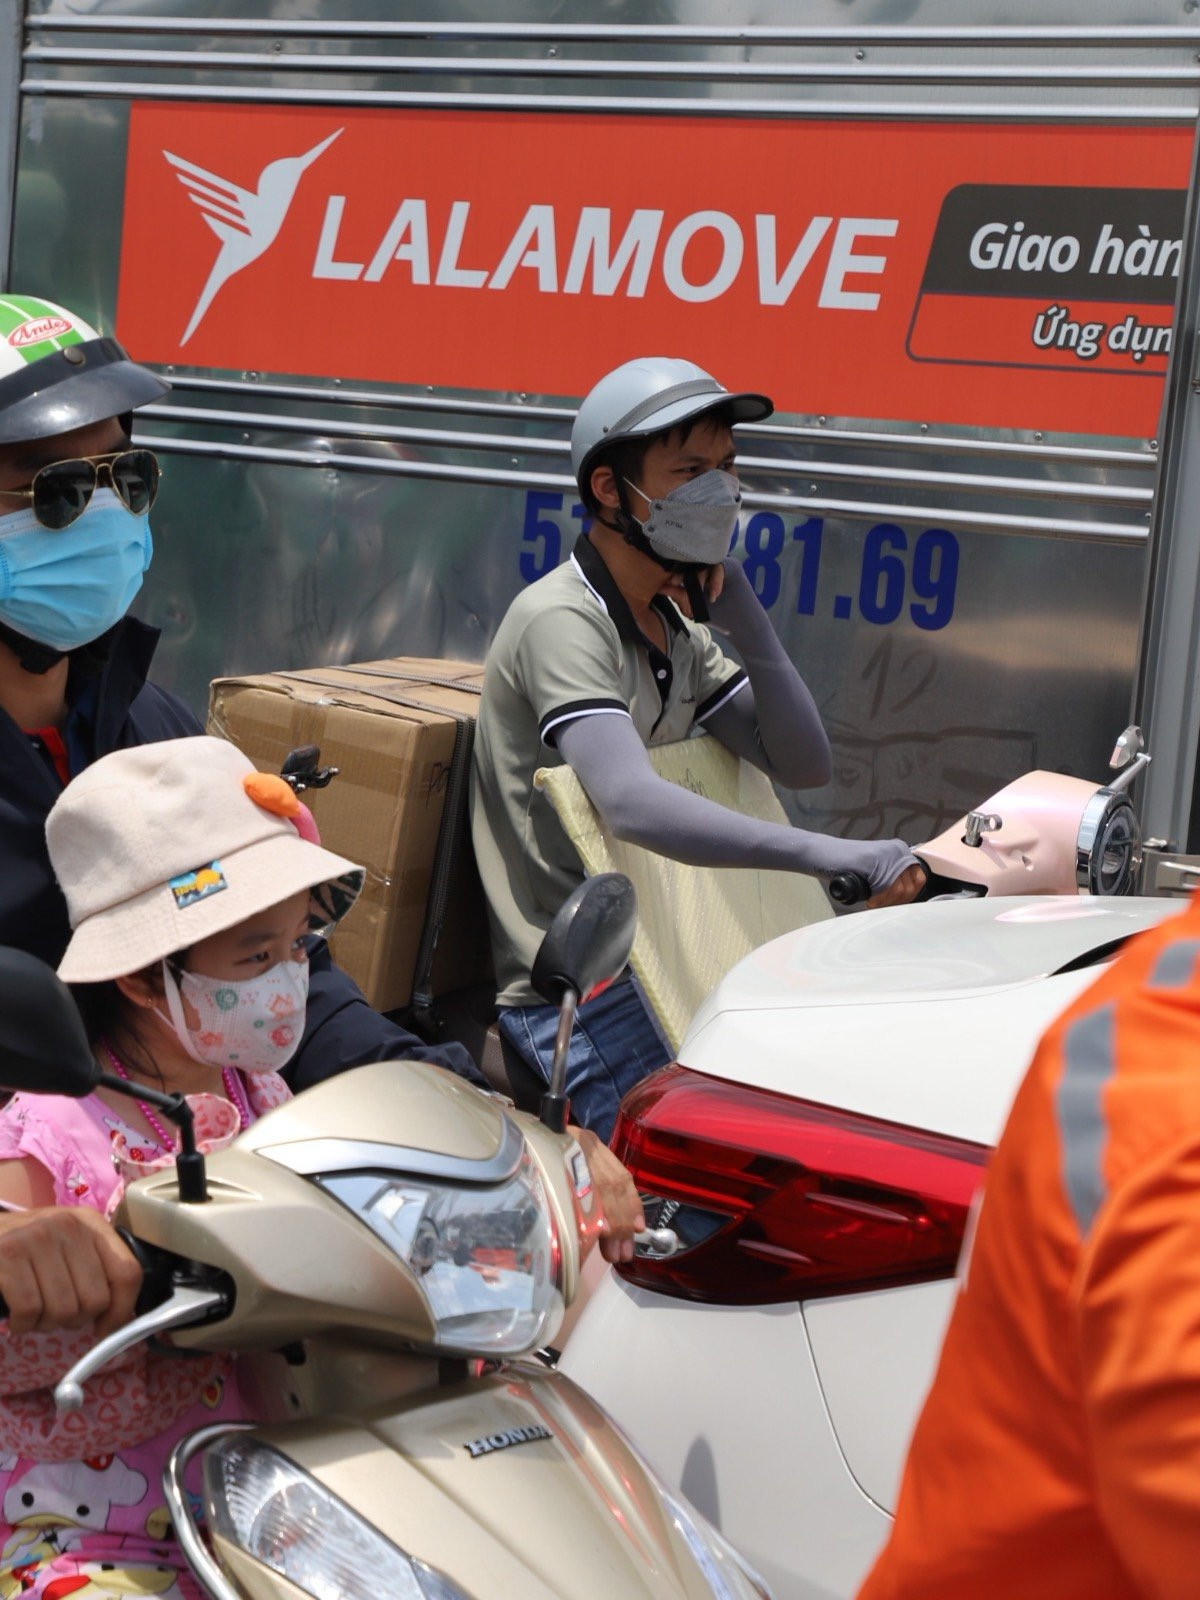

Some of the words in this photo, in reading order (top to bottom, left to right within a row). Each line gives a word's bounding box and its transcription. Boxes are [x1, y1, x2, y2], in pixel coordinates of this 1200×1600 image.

[312, 195, 899, 311] LALAMOVE
[969, 221, 1081, 273] Giao
[1032, 305, 1103, 358] Ứng
[728, 511, 960, 632] 81.69
[463, 1425, 553, 1458] HONDA
